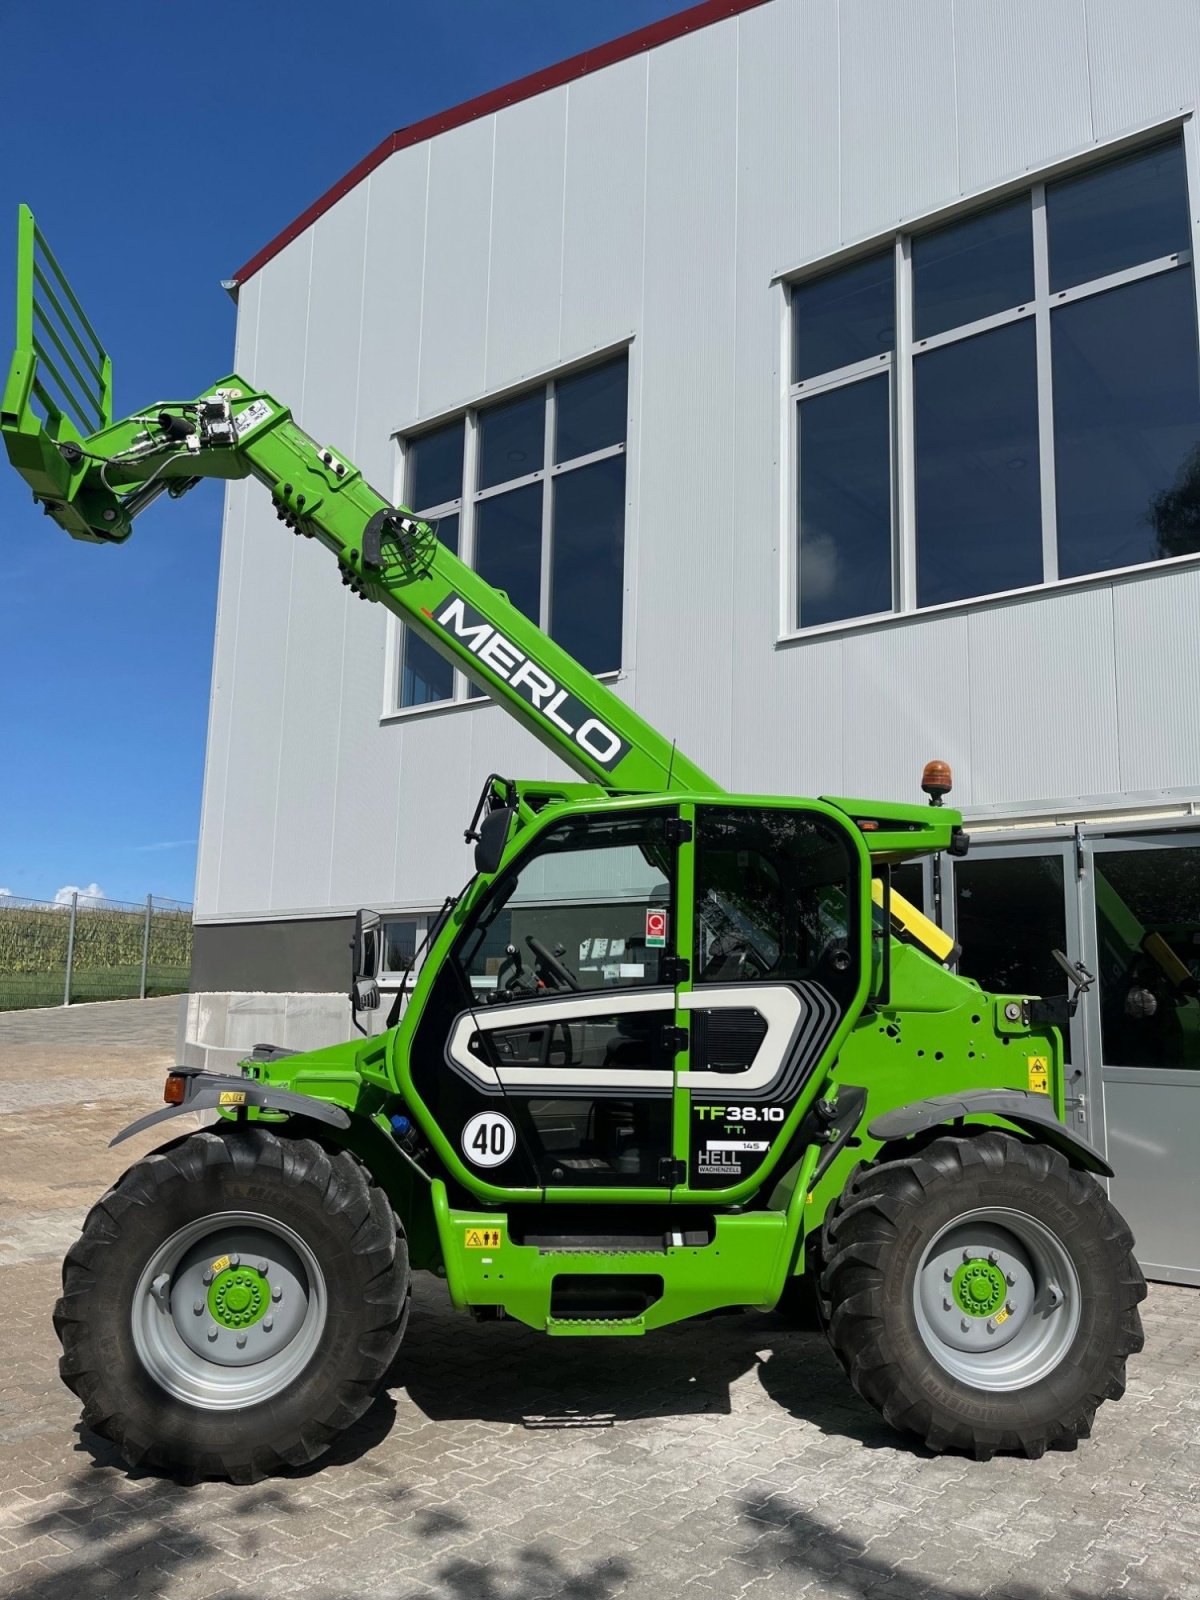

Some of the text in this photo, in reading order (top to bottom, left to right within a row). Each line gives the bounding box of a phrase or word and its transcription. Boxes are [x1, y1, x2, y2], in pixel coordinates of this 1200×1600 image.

[437, 597, 622, 763] MERLO
[649, 915, 663, 930] Q
[693, 1105, 785, 1122] TF38.10
[472, 1123, 506, 1156] 40
[698, 1150, 741, 1165] HELL
[698, 1166, 741, 1174] WACHENZELL
